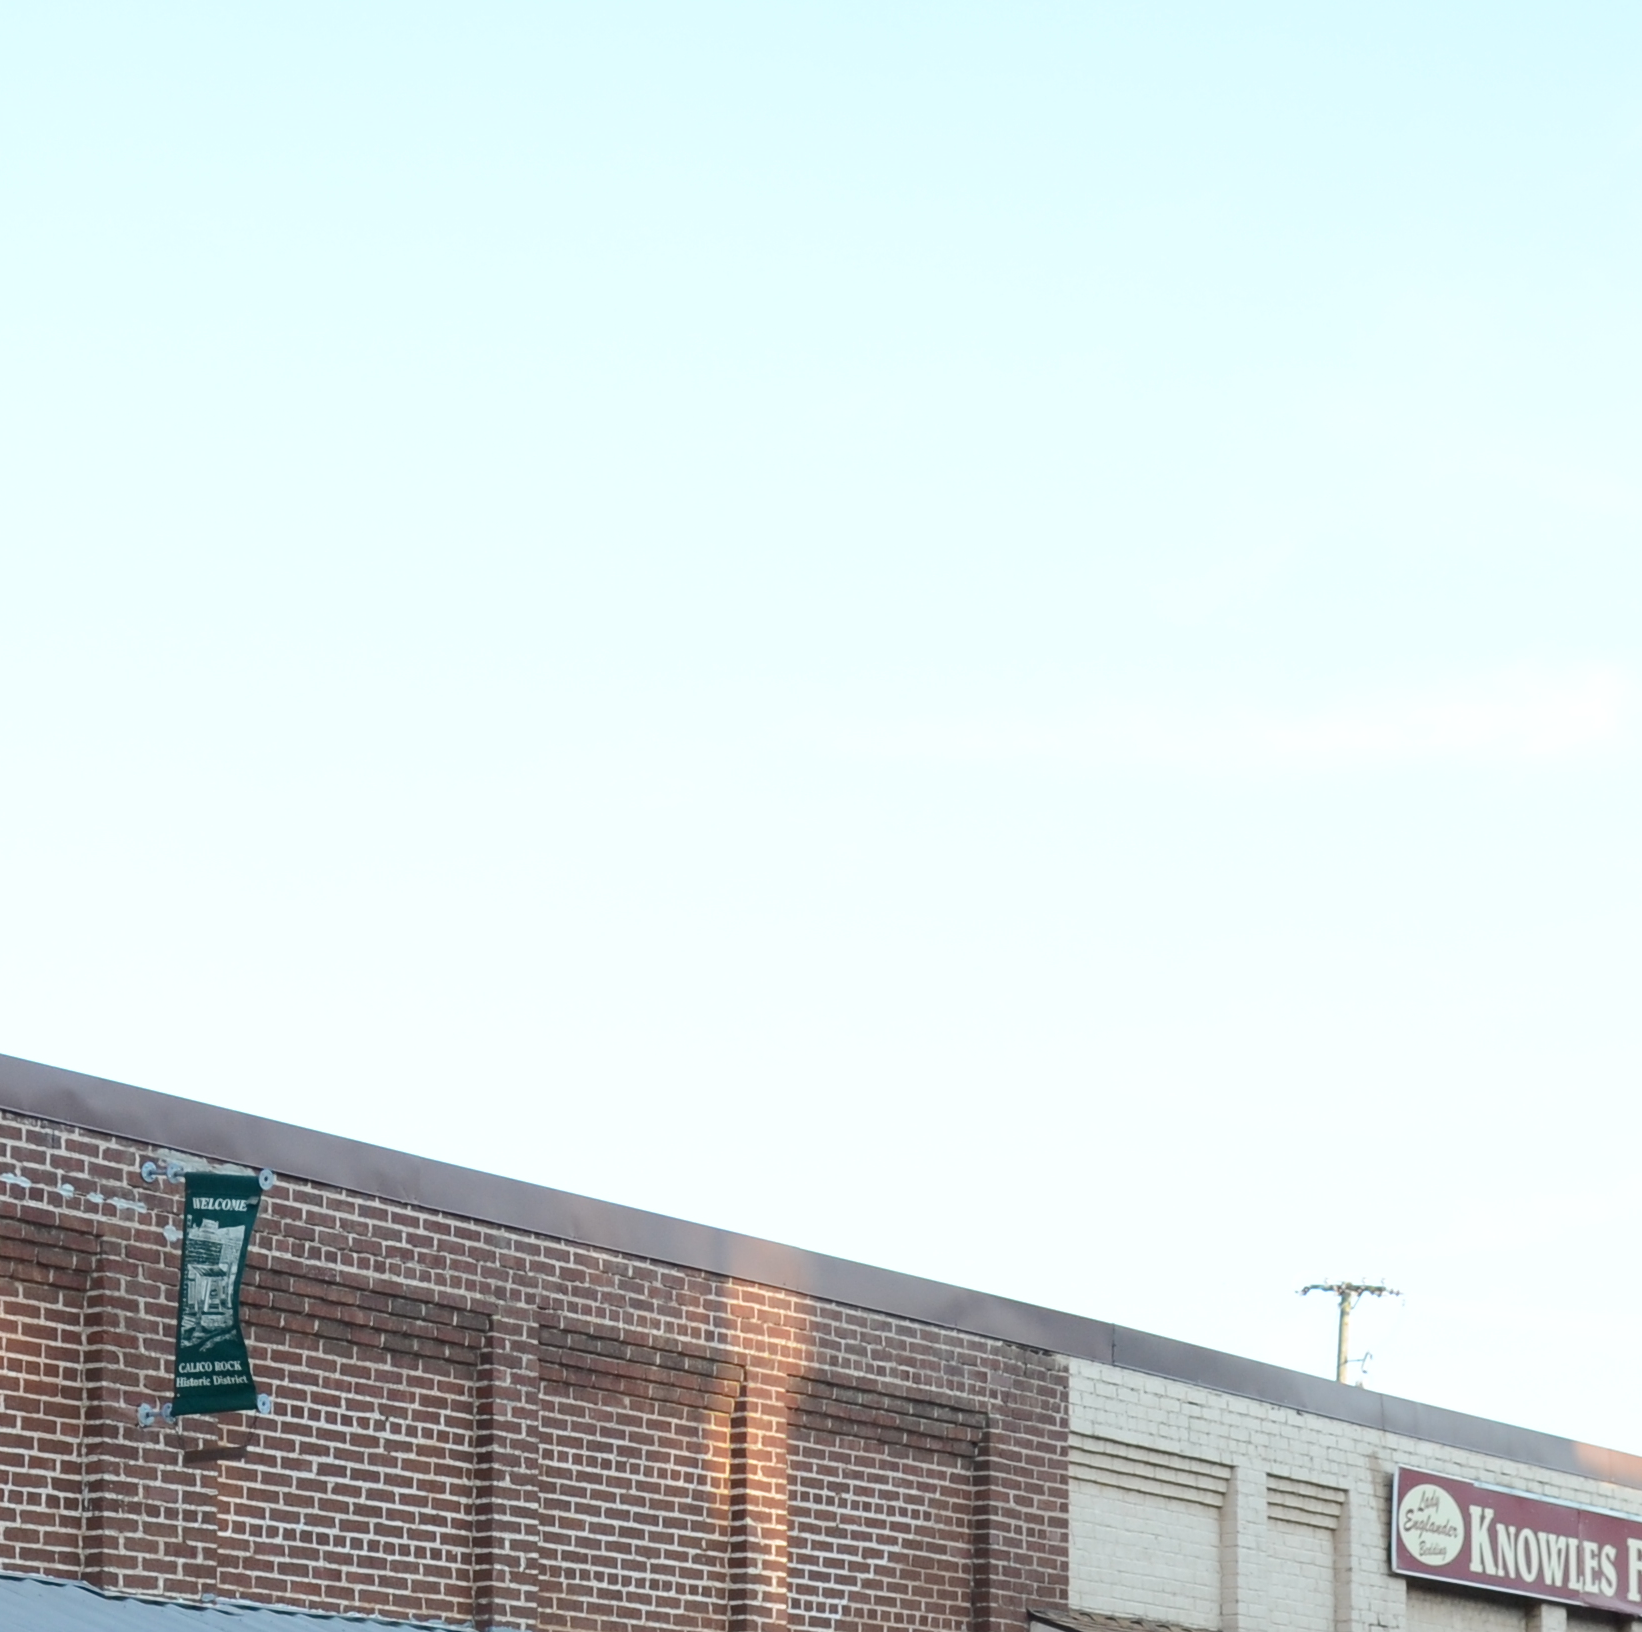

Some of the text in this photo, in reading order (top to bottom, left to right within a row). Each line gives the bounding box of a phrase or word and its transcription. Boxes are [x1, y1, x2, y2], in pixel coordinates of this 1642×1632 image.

[192, 1197, 248, 1212] WELCOME
[178, 1360, 242, 1373] CALICO ROCK
[176, 1375, 248, 1387] Historic District
[1403, 1508, 1458, 1539] Englander
